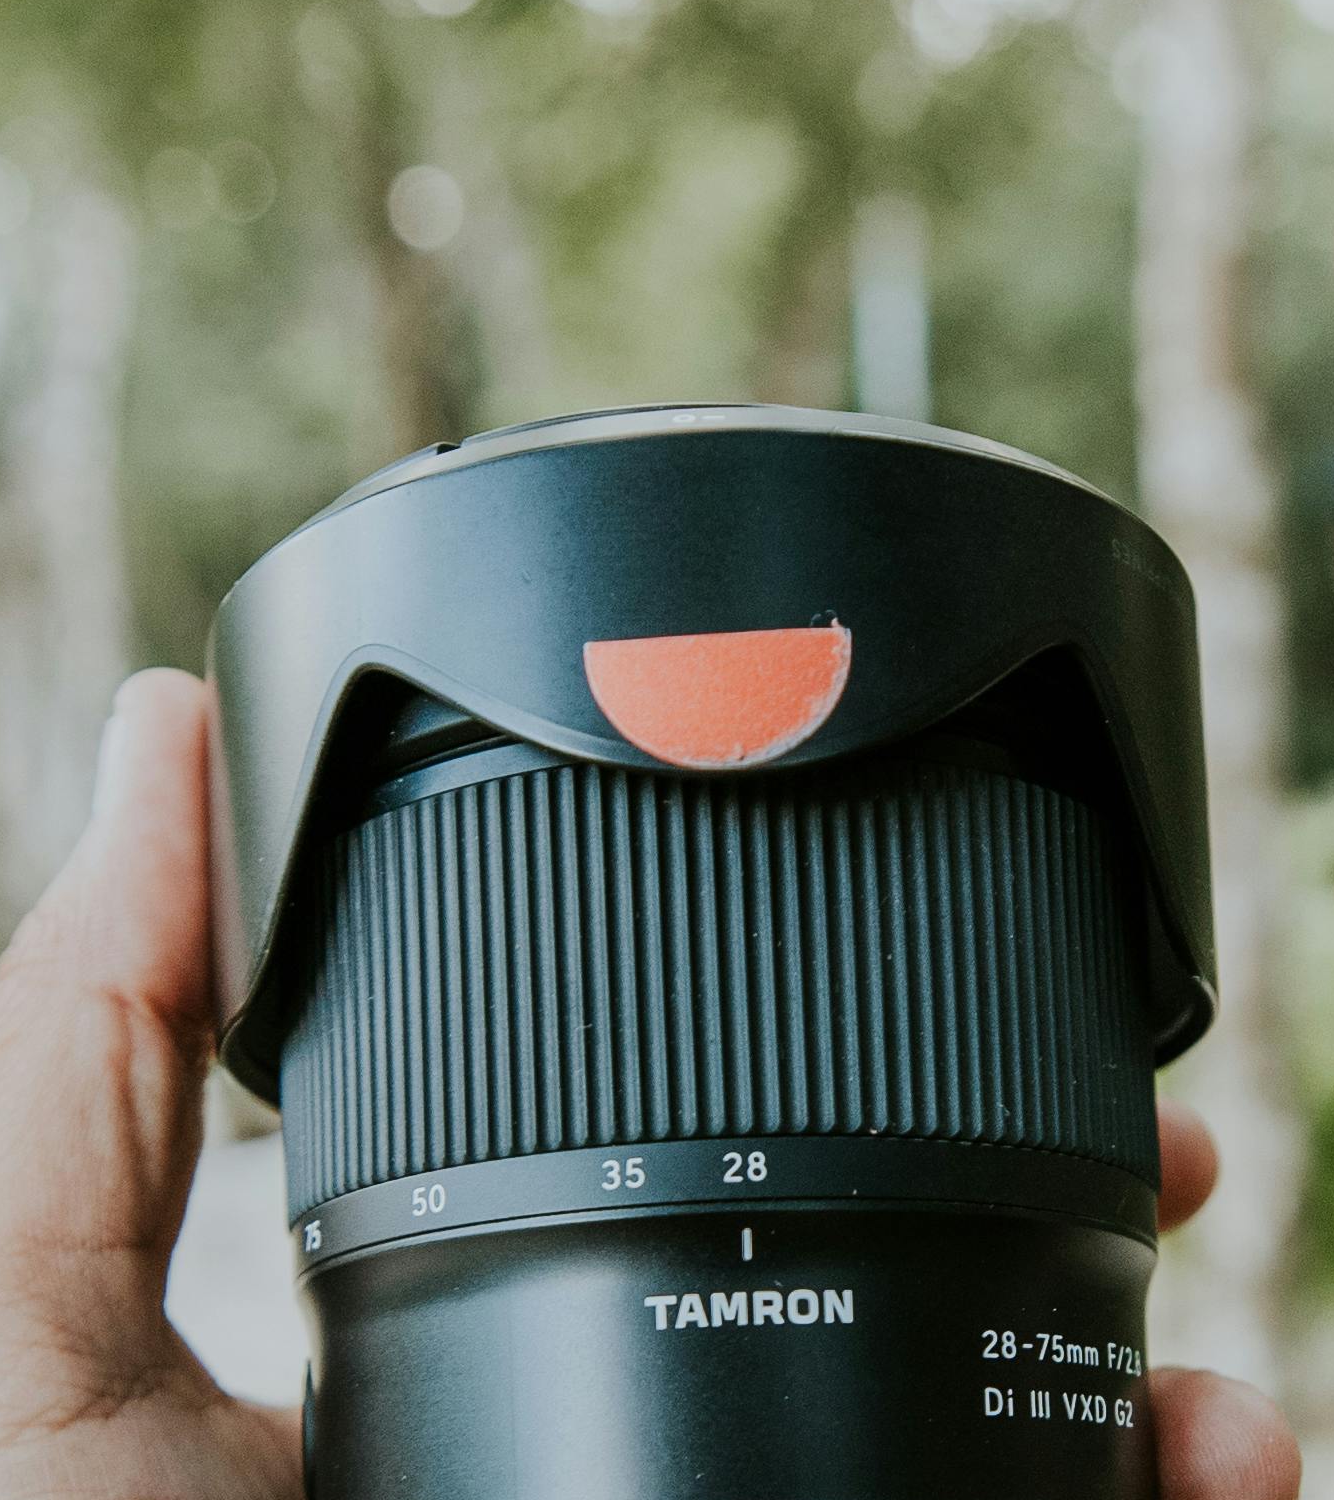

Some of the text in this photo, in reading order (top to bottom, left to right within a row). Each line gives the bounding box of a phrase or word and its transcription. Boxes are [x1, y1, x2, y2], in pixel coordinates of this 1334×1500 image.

[411, 1183, 446, 1217] 50
[600, 1157, 646, 1191] 35
[722, 1150, 768, 1184] 28
[643, 1288, 854, 1331] TAMRON
[981, 1329, 1100, 1367] 28-75mm
[984, 1386, 1134, 1429] Di III VXD G2
